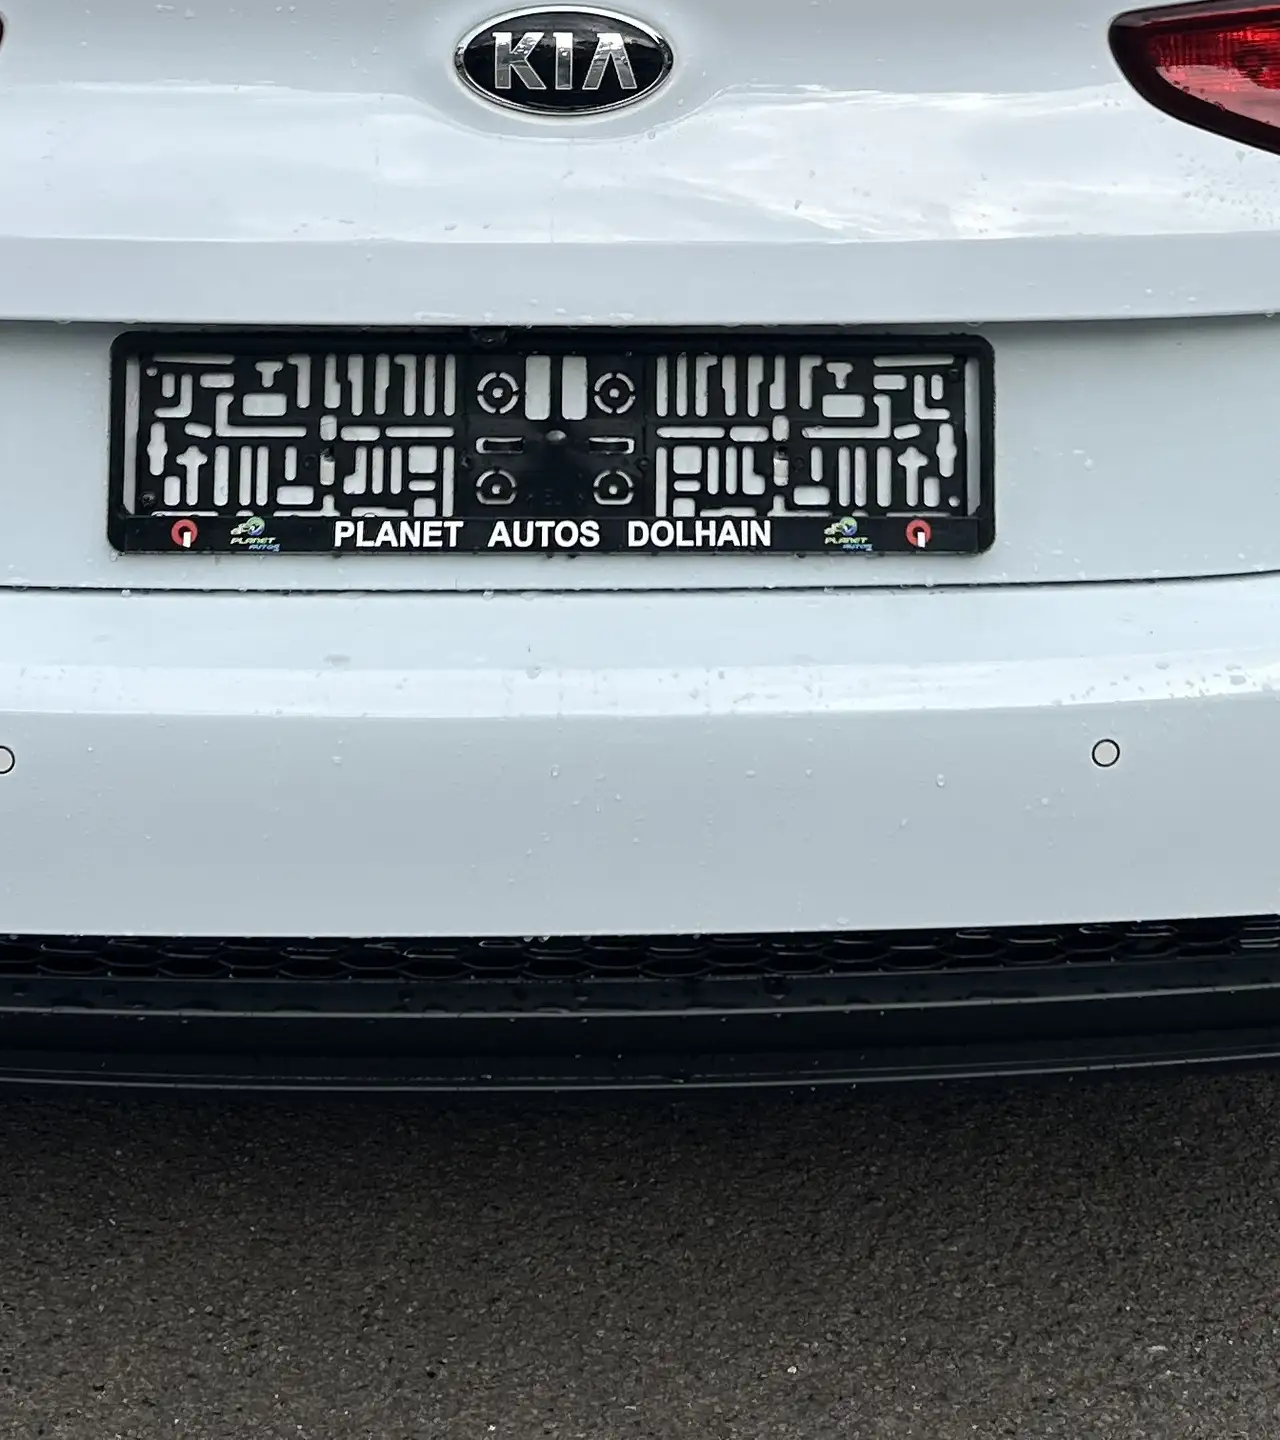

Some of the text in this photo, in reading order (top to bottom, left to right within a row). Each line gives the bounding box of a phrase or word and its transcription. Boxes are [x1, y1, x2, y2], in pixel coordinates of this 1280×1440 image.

[492, 32, 638, 91] KIA
[333, 520, 772, 548] PLANET AUTOS DOLHAIN
